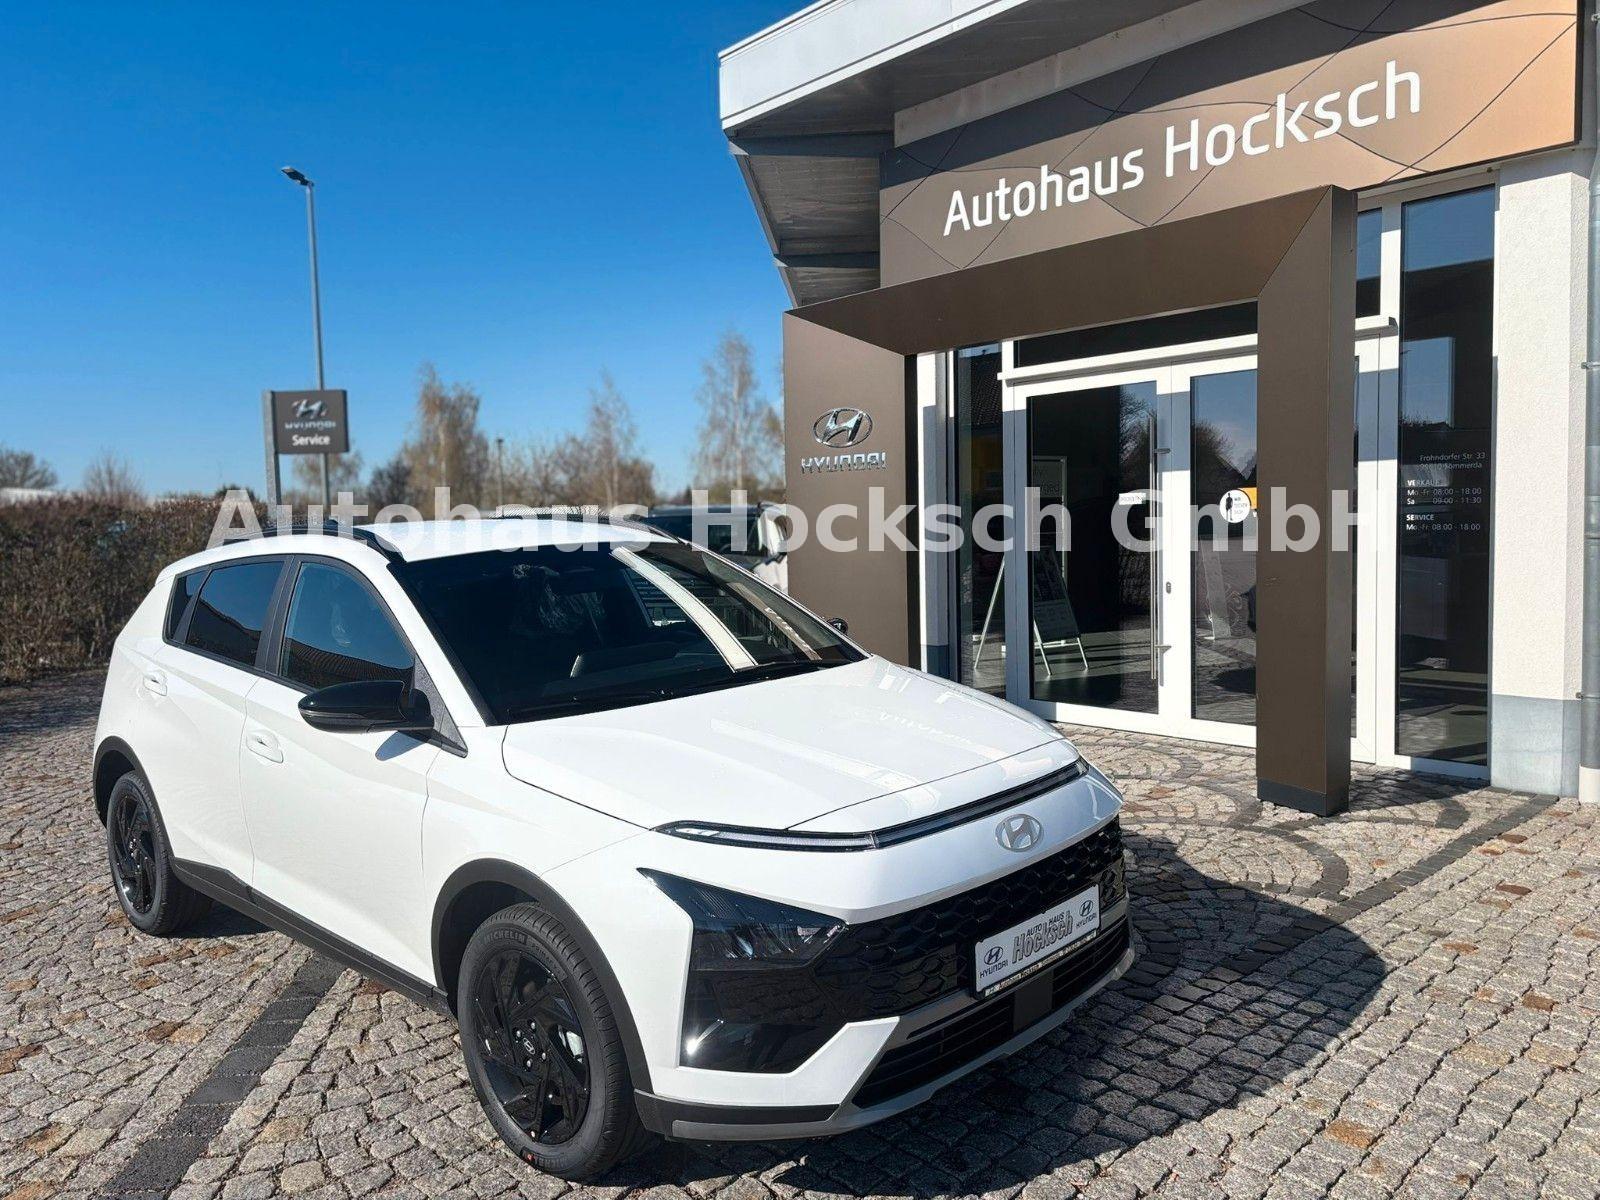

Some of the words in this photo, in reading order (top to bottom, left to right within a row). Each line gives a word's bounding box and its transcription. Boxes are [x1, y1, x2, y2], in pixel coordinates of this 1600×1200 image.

[943, 148, 1145, 236] Autohaus
[1165, 60, 1420, 177] Hocksch
[292, 433, 331, 446] Service
[801, 452, 887, 474] HYUNDAI
[1025, 922, 1043, 937] AUTO
[1048, 912, 1065, 927] HAUS
[1075, 913, 1098, 929] HYUNDAI
[1012, 910, 1074, 964] Hocksch
[979, 959, 1009, 979] HYUNDAI
